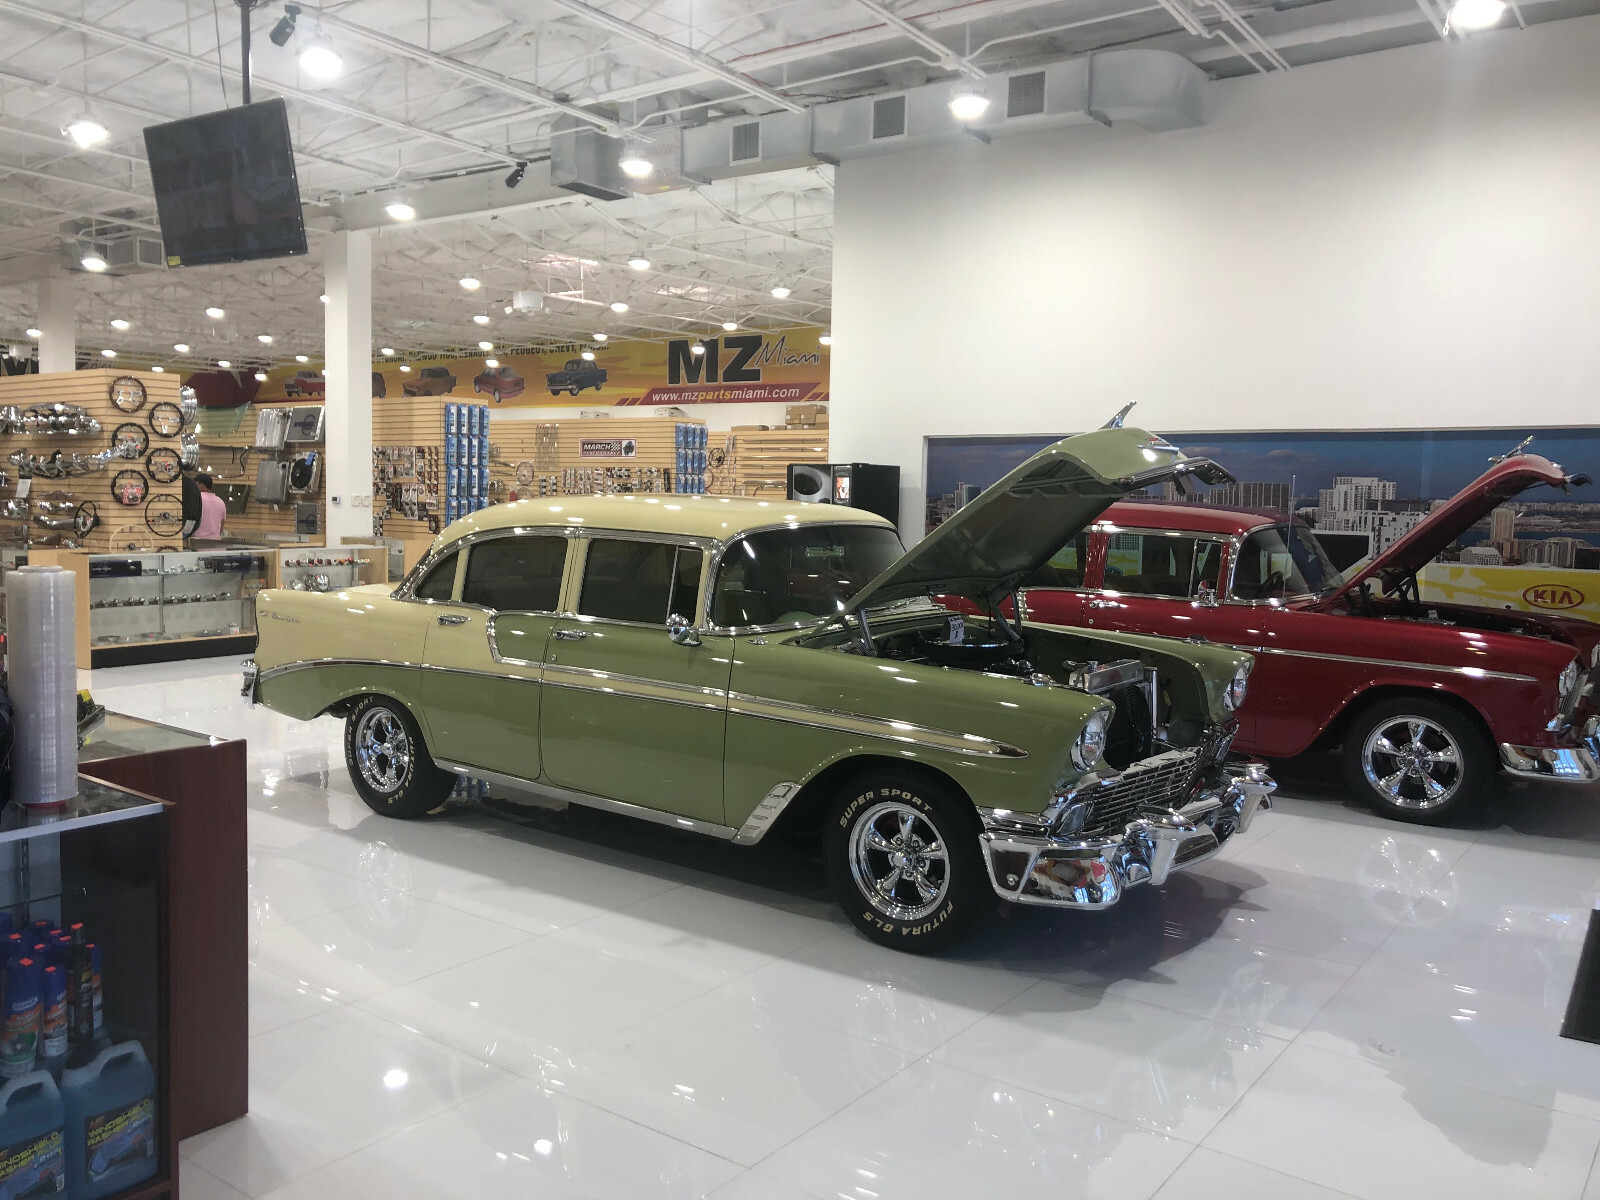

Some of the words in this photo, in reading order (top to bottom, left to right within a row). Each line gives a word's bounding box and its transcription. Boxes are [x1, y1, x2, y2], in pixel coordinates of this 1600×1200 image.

[668, 335, 763, 385] MZ
[755, 335, 821, 367] Miami
[652, 387, 800, 402] www.mzpartsmiami.com
[1533, 589, 1574, 604] KIA
[839, 791, 874, 828] SUPER
[880, 788, 933, 811] SPORT
[862, 911, 894, 934] GLS
[901, 900, 954, 936] FUTURA
[0, 1131, 60, 1170] INDSHIELD
